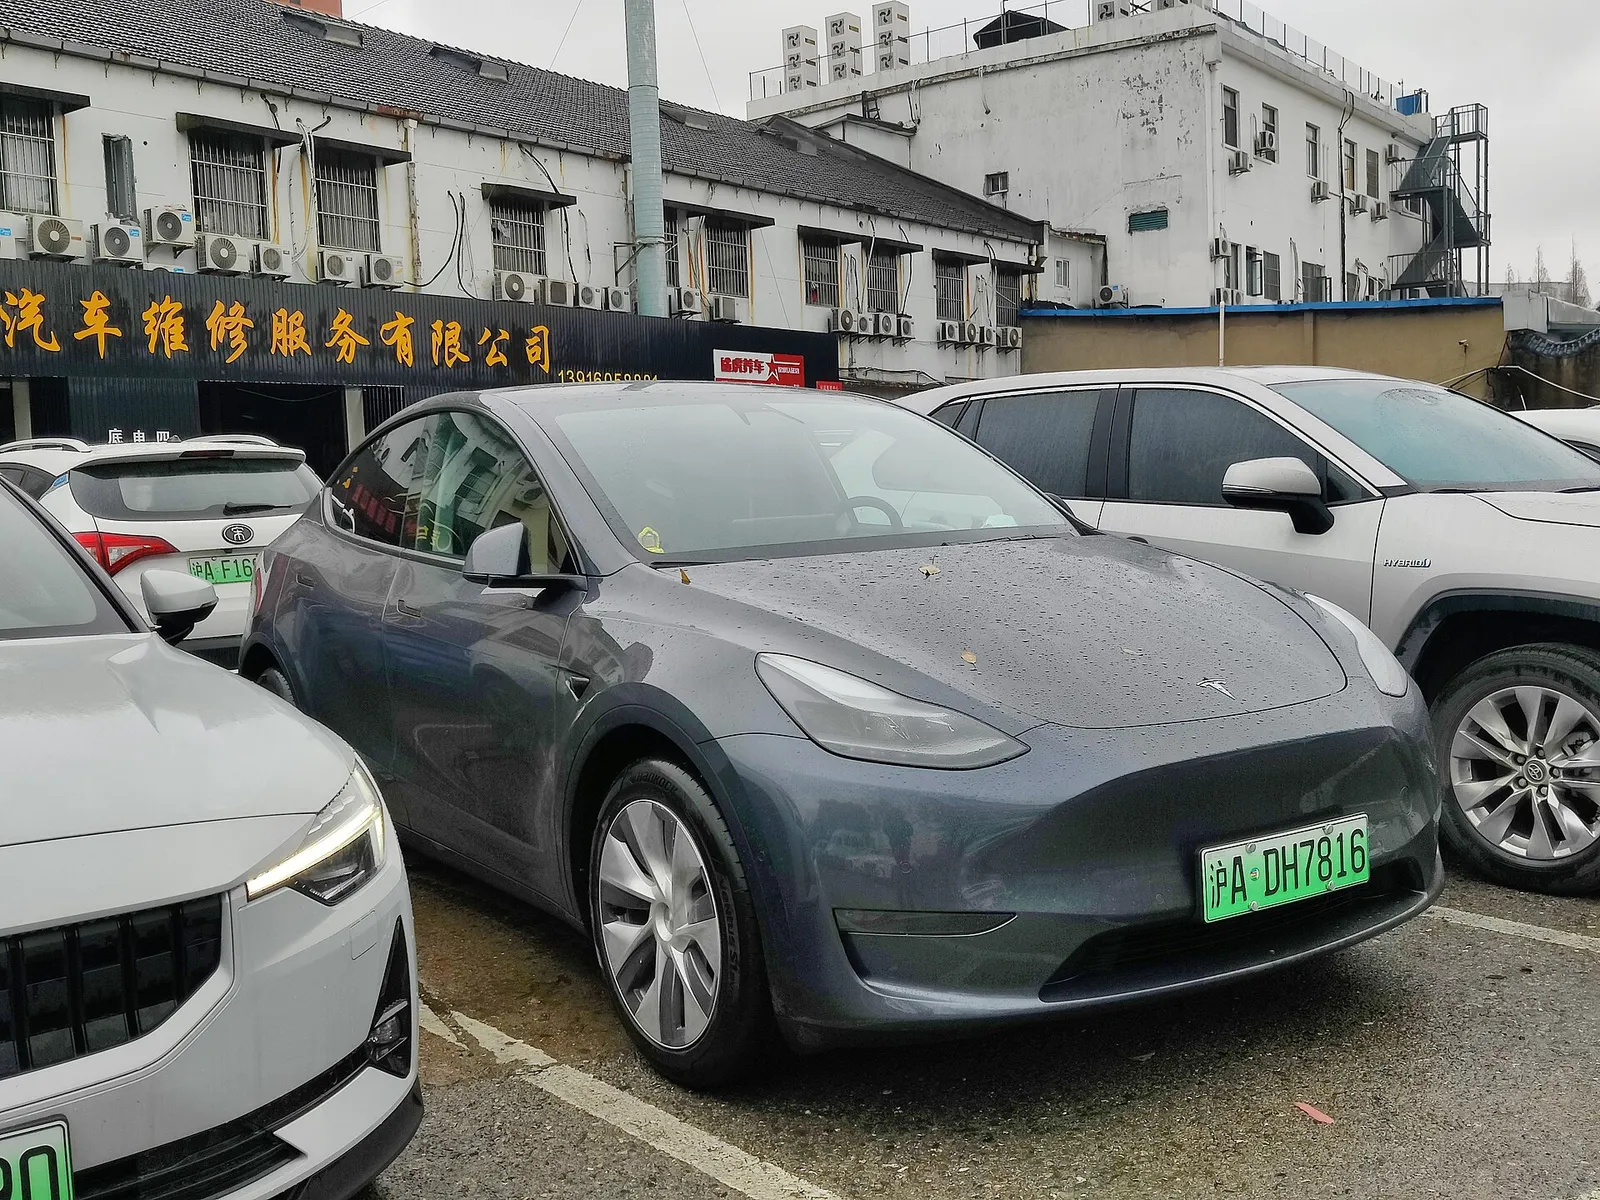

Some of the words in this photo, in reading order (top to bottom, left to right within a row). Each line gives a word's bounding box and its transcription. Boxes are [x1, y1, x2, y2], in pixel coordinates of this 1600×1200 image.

[0, 287, 550, 374] 汽车维修服务有限公司
[1383, 558, 1428, 568] HYBRID
